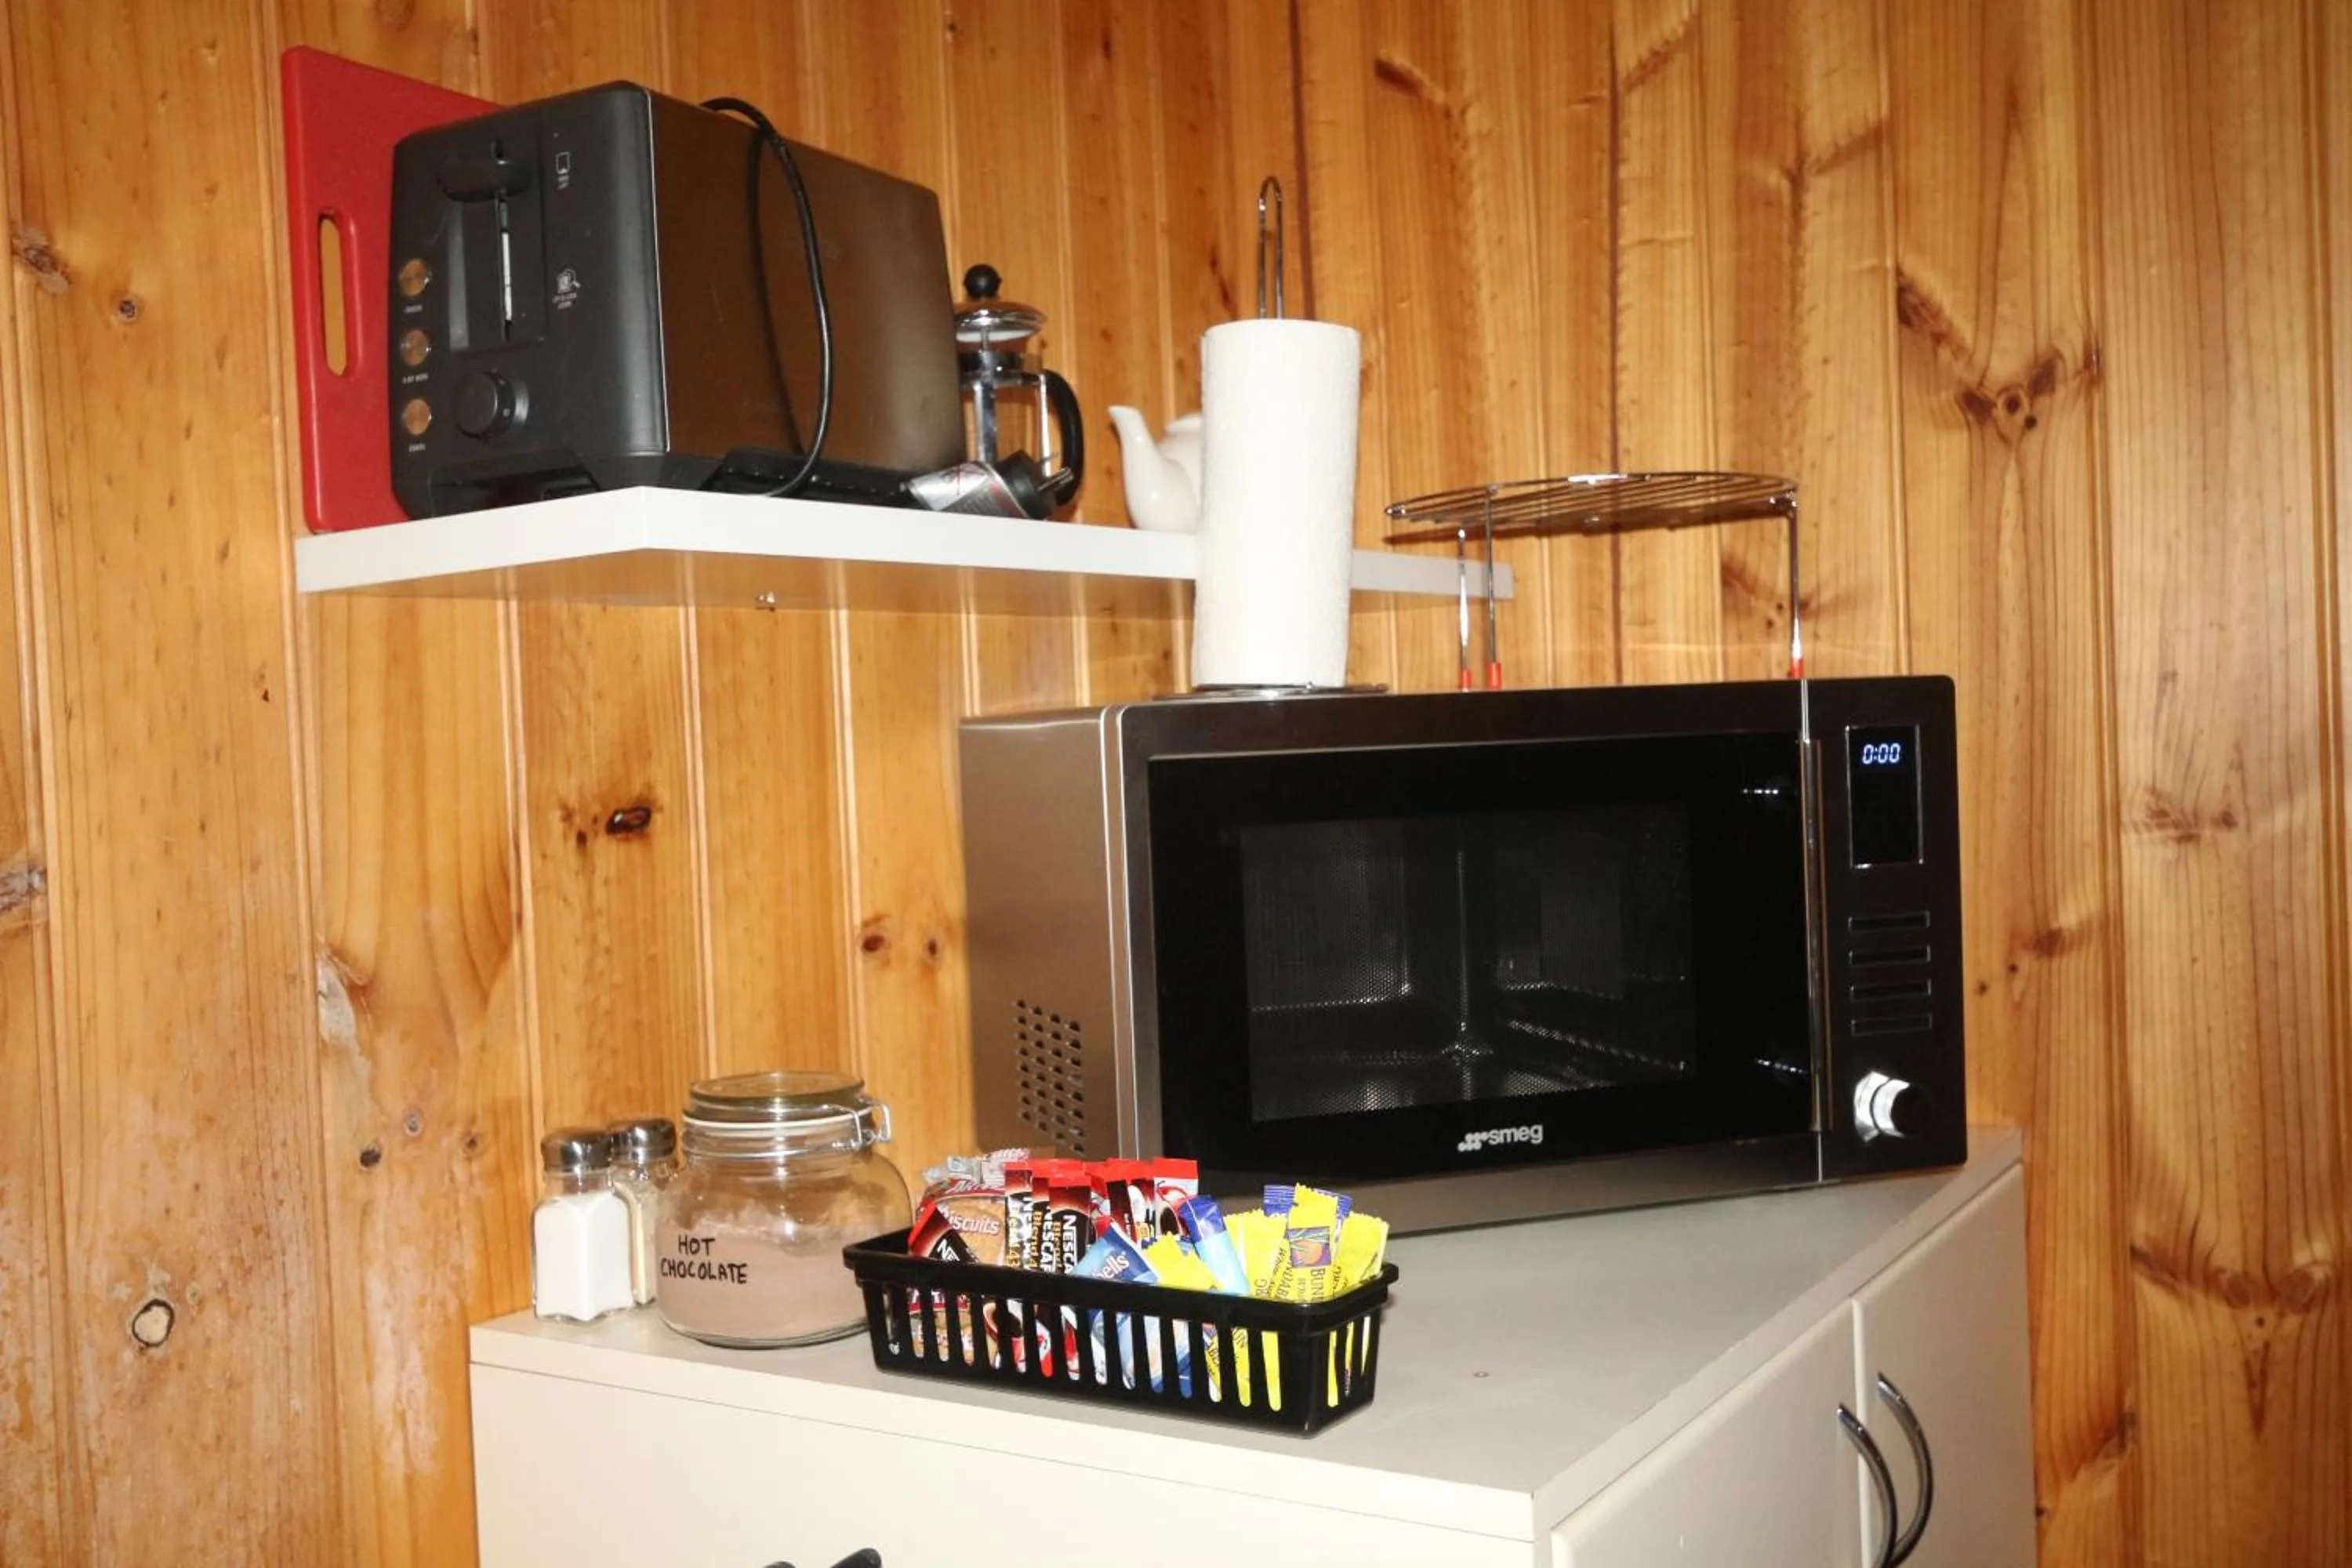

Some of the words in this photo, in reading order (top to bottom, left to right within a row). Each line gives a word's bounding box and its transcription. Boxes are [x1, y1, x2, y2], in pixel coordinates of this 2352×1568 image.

[1862, 742, 1901, 764] 0:00
[1488, 1123, 1544, 1145] smeg
[678, 1233, 716, 1256] HOT
[660, 1257, 748, 1284] CHOCOLATE
